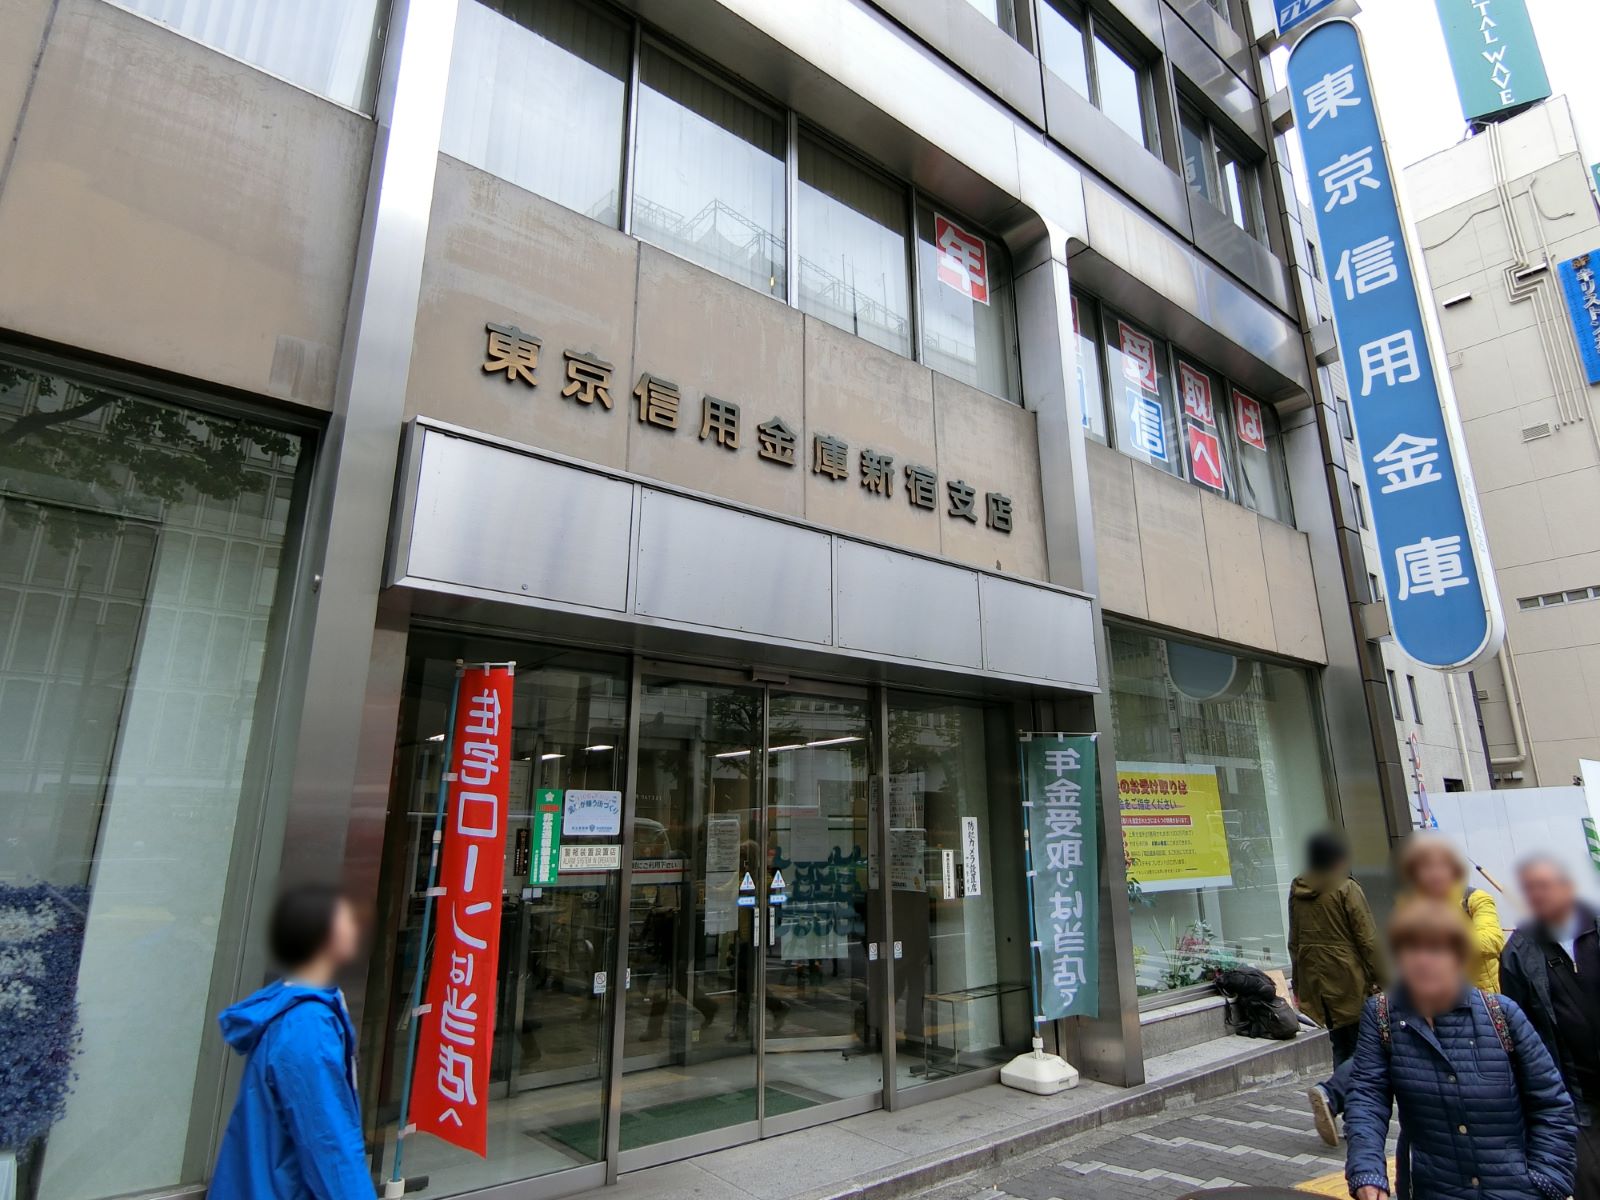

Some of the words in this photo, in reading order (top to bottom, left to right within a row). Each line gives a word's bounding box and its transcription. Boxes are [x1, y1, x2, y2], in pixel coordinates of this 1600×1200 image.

[1471, 0, 1498, 44] TAL
[1481, 45, 1515, 106] WAVE
[938, 225, 984, 292] 年
[1303, 63, 1470, 601] 東京信用金庫
[1576, 268, 1600, 354] キリスト
[483, 320, 1013, 533] 東京信用金庫新宿支店
[1118, 778, 1188, 795] のお受け取りは
